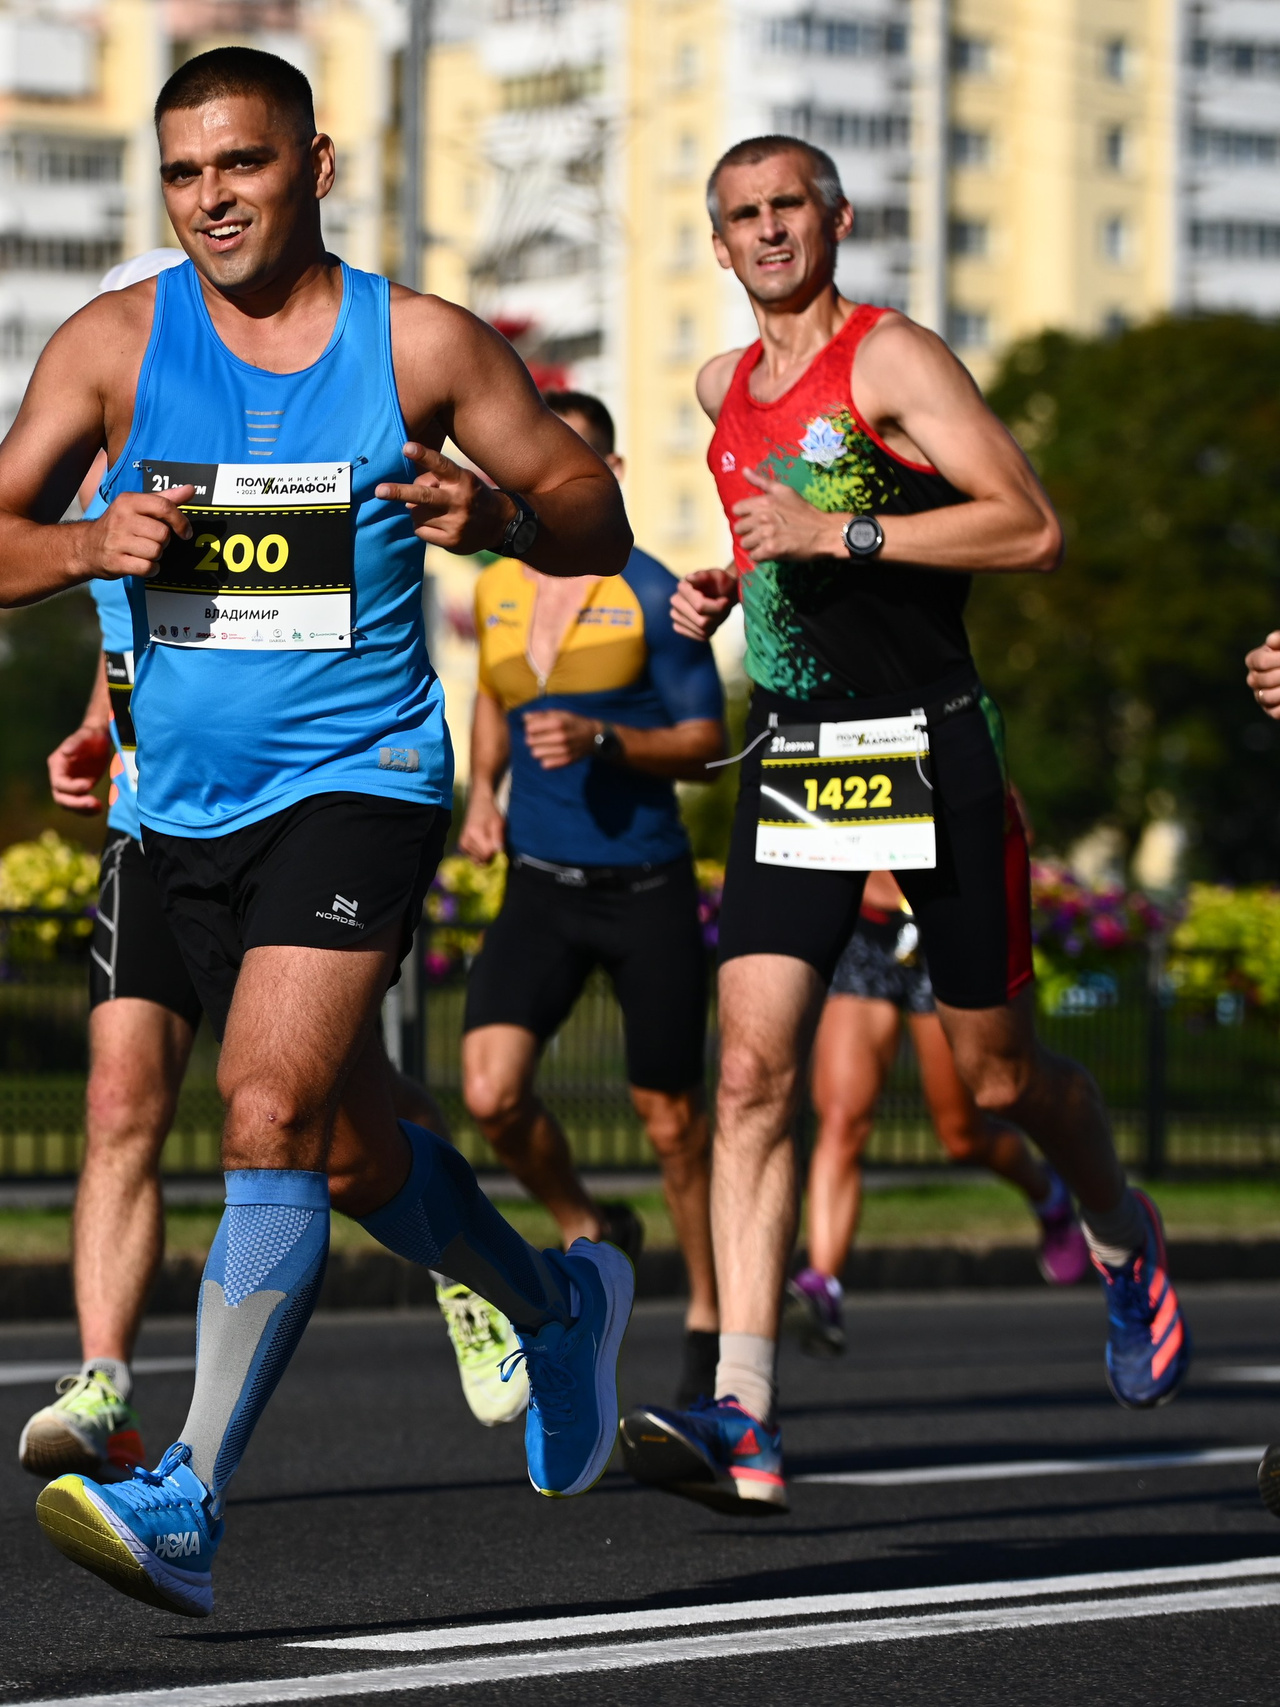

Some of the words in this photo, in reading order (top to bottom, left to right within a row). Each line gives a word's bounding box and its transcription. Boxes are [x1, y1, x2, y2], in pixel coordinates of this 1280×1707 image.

[267, 482, 336, 495] МАРАФОН
[193, 533, 289, 573] 200
[204, 608, 279, 621] ВЛАДИМИР
[804, 774, 892, 811] 1422
[315, 911, 365, 929] NORDSKI
[154, 1531, 200, 1558] HOKA
